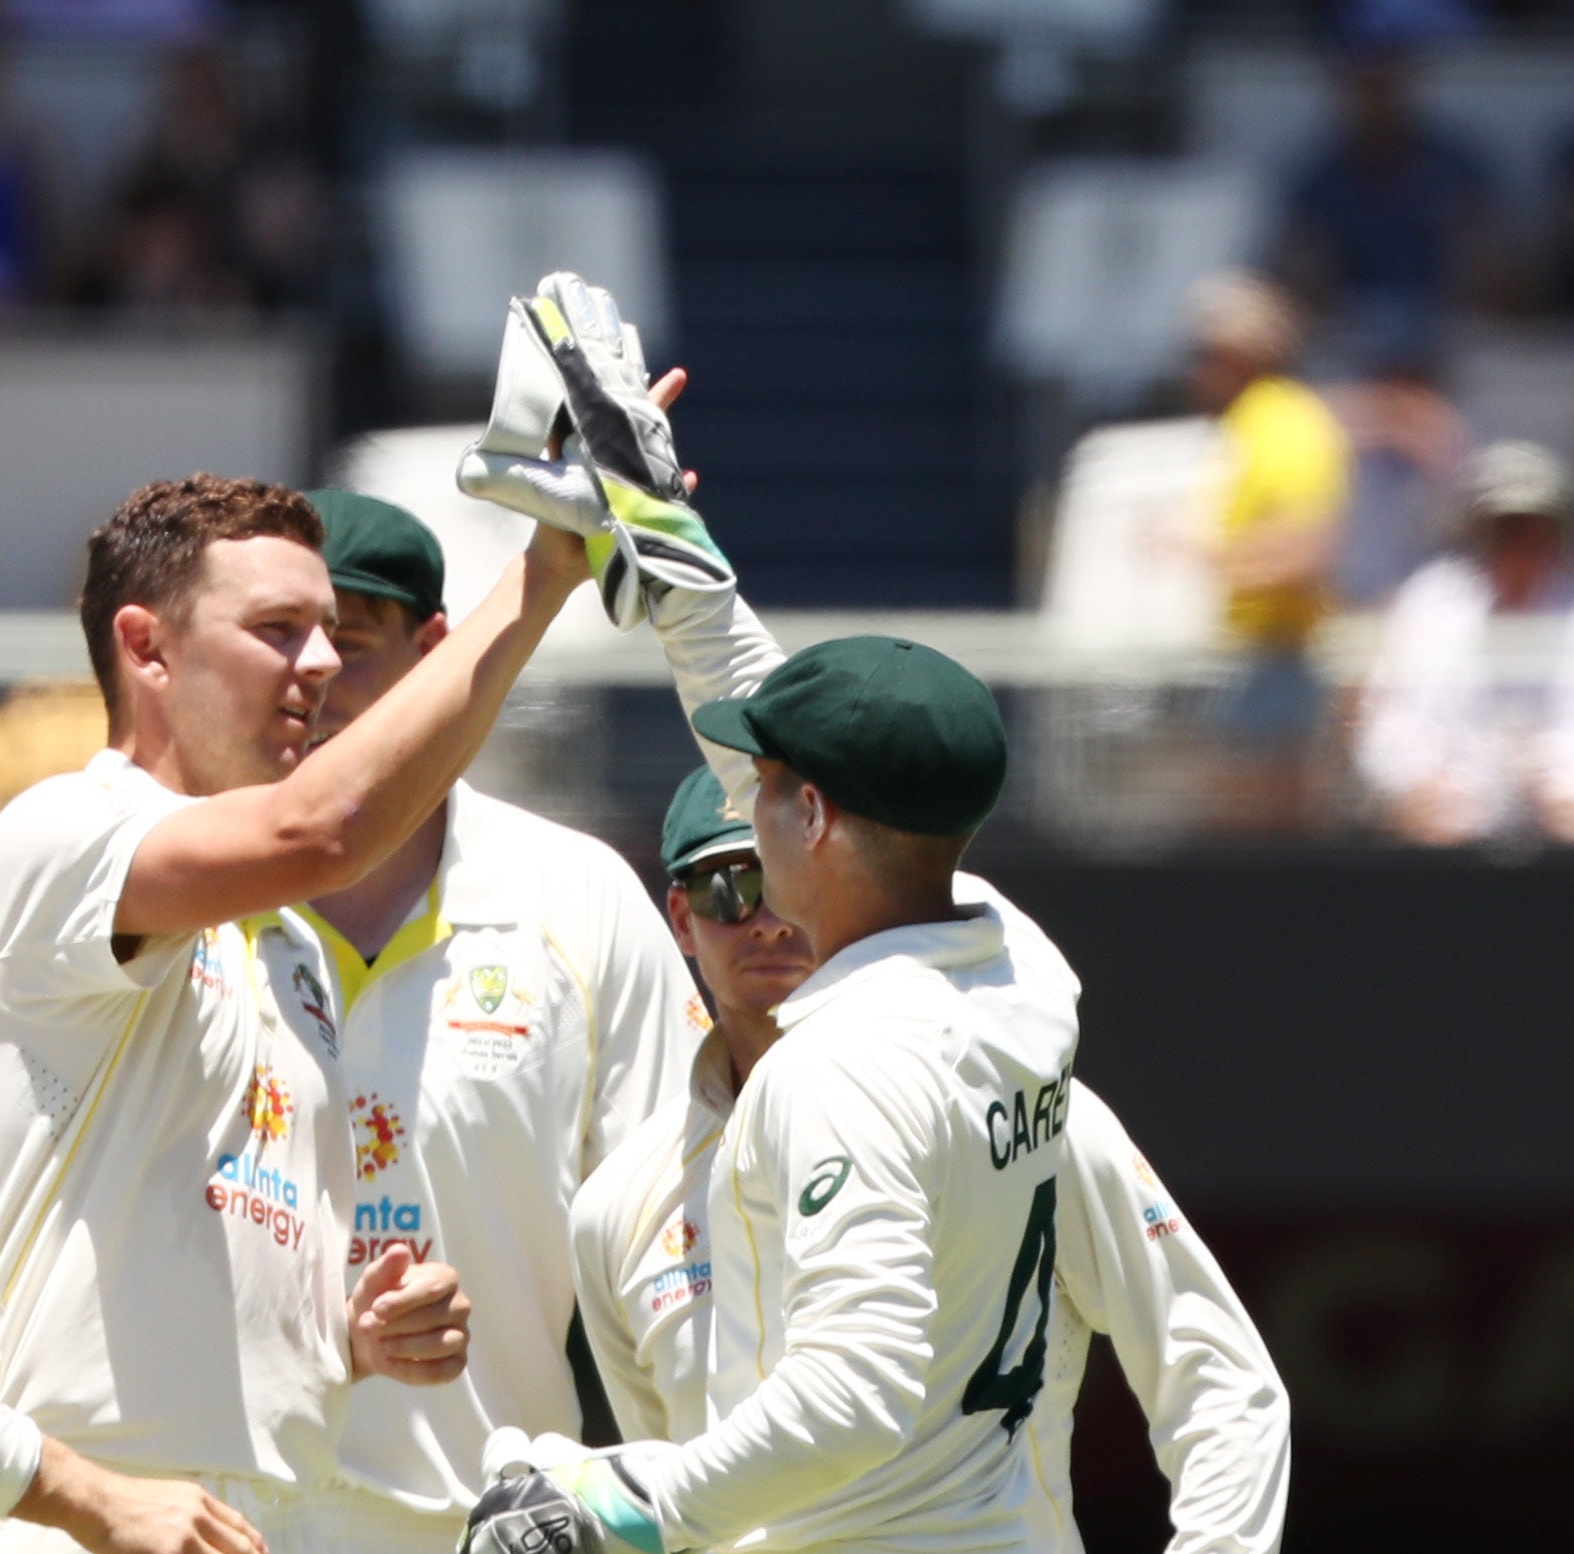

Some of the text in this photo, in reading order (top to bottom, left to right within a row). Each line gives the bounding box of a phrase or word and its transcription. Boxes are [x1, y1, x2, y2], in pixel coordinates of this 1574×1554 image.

[986, 1062, 1074, 1171] CARE
[217, 1152, 298, 1210] alinta
[354, 1195, 421, 1231] nta
[205, 1183, 305, 1251] energy
[961, 1175, 1057, 1445] 4
